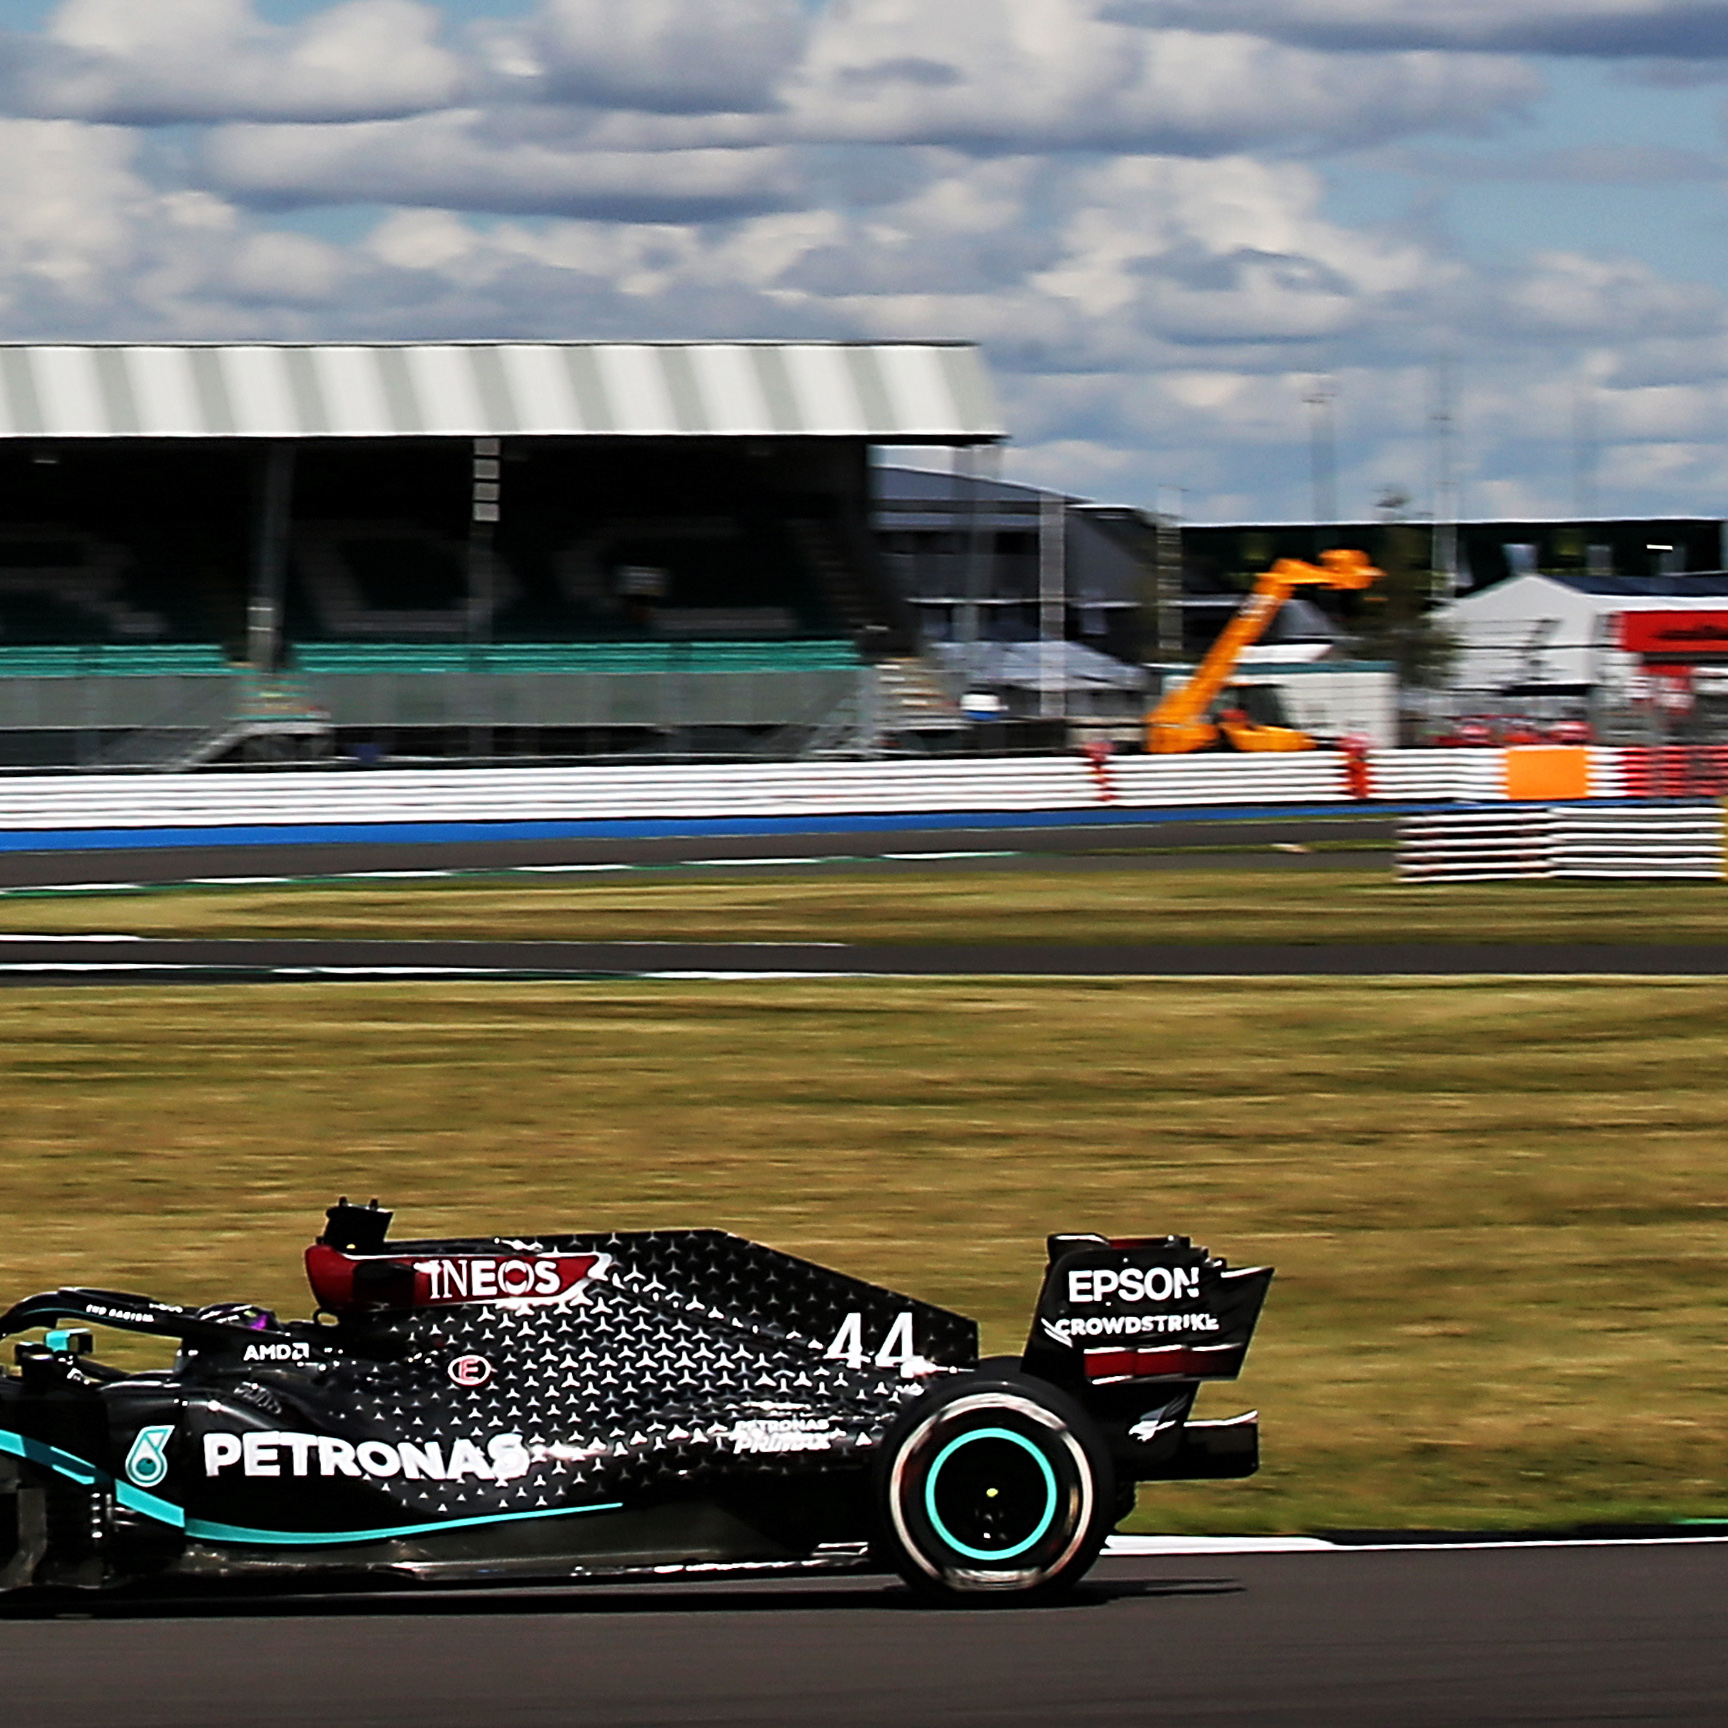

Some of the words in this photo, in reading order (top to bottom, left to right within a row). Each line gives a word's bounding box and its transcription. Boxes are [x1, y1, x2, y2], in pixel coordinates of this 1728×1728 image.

[430, 1259, 561, 1299] INEOS
[1068, 1267, 1200, 1302] EPSON
[1055, 1313, 1220, 1336] CROWDSTRIKE
[244, 1344, 292, 1361] AMD
[823, 1312, 925, 1378] 44
[734, 1419, 830, 1432] PETRONAS
[203, 1431, 530, 1479] PETRONAS
